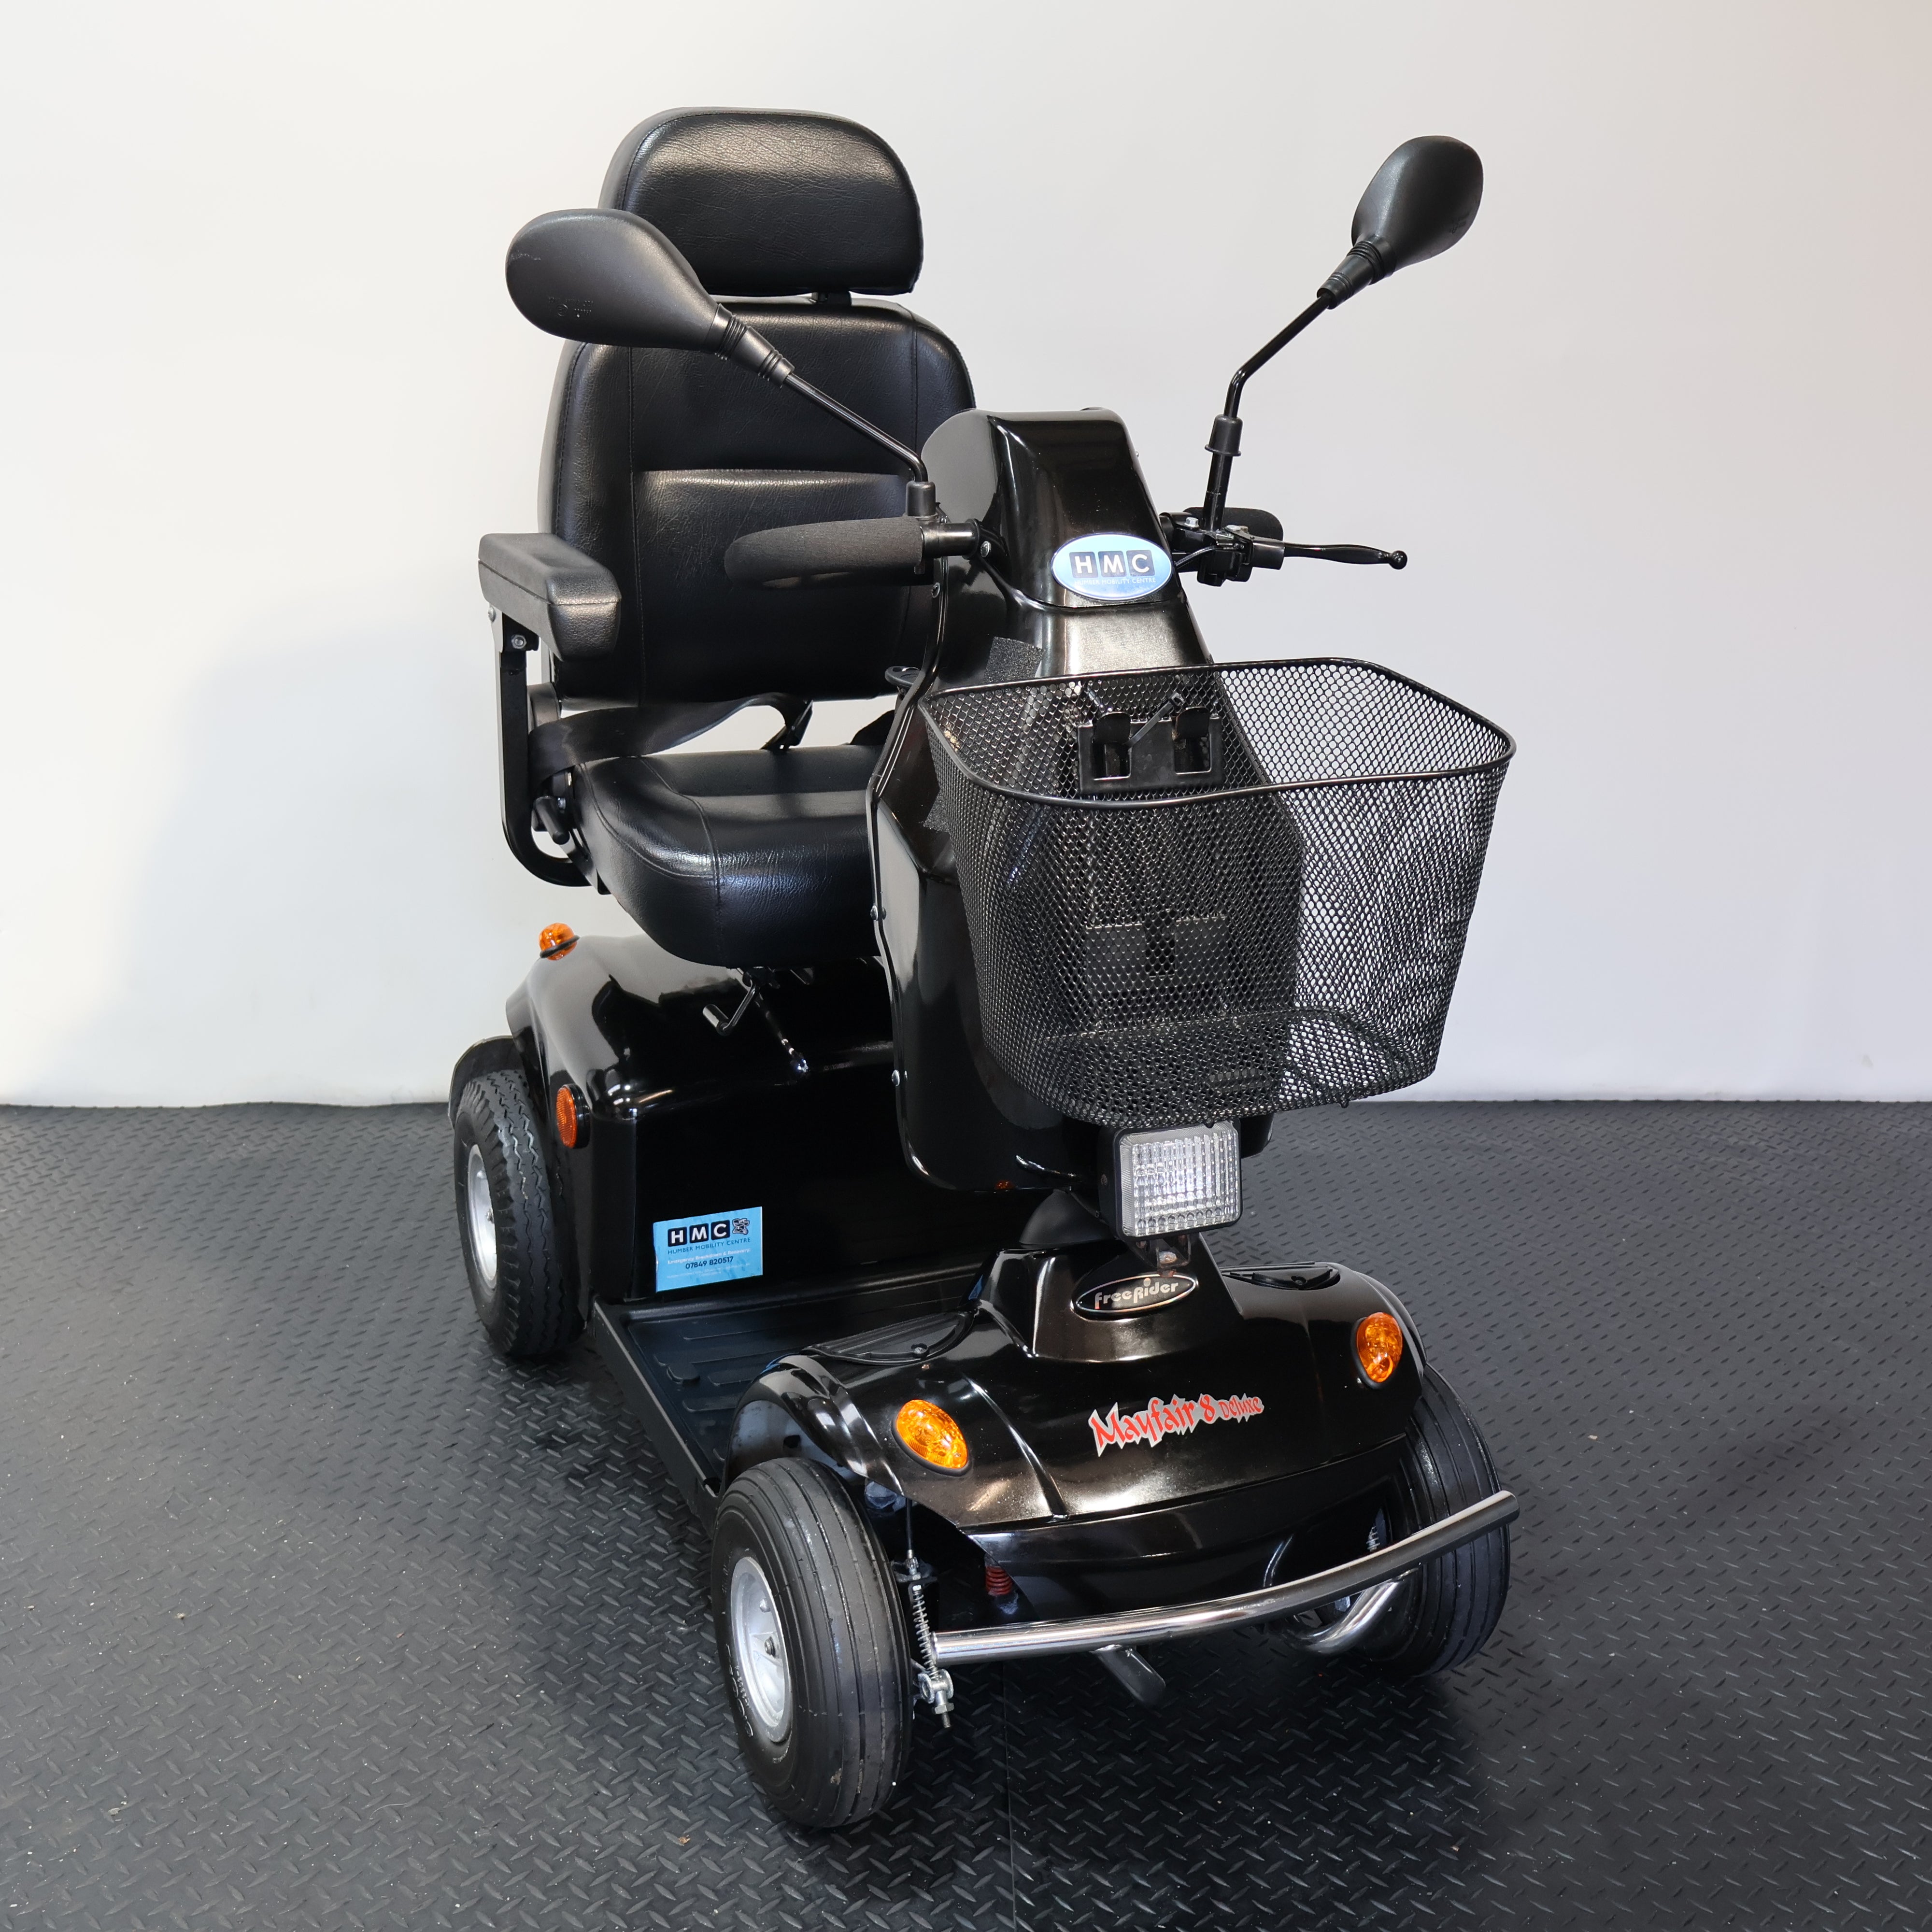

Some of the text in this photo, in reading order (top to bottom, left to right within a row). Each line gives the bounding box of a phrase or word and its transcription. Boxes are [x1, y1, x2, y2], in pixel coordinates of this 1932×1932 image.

[1074, 553, 1151, 575] HMC
[670, 1223, 727, 1244] HMC
[668, 1237, 751, 1255] HUMBER MOBILITY CENTRE
[685, 1256, 734, 1269] 07849 820517
[1090, 1398, 1195, 1449] Mayfair
[1199, 1394, 1216, 1422] 8
